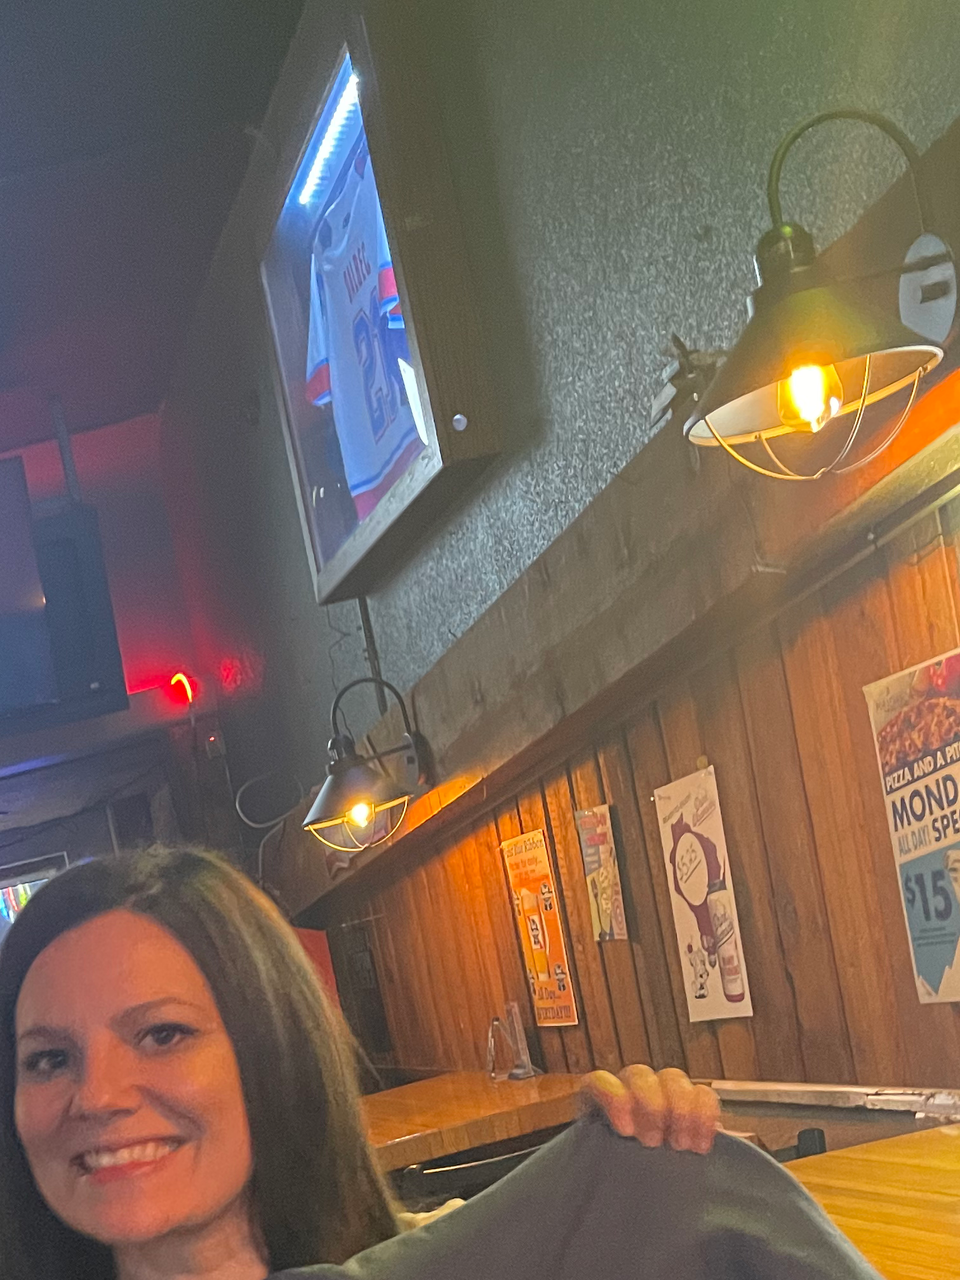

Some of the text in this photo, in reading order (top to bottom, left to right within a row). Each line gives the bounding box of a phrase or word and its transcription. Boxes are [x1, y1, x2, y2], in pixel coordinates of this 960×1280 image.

[885, 767, 912, 791] PIZZA
[913, 756, 934, 779] AND
[937, 751, 945, 768] A
[892, 774, 959, 832] MOND
[898, 833, 912, 857] ALL
[911, 825, 932, 850] DAY!
[904, 869, 953, 921] $15
